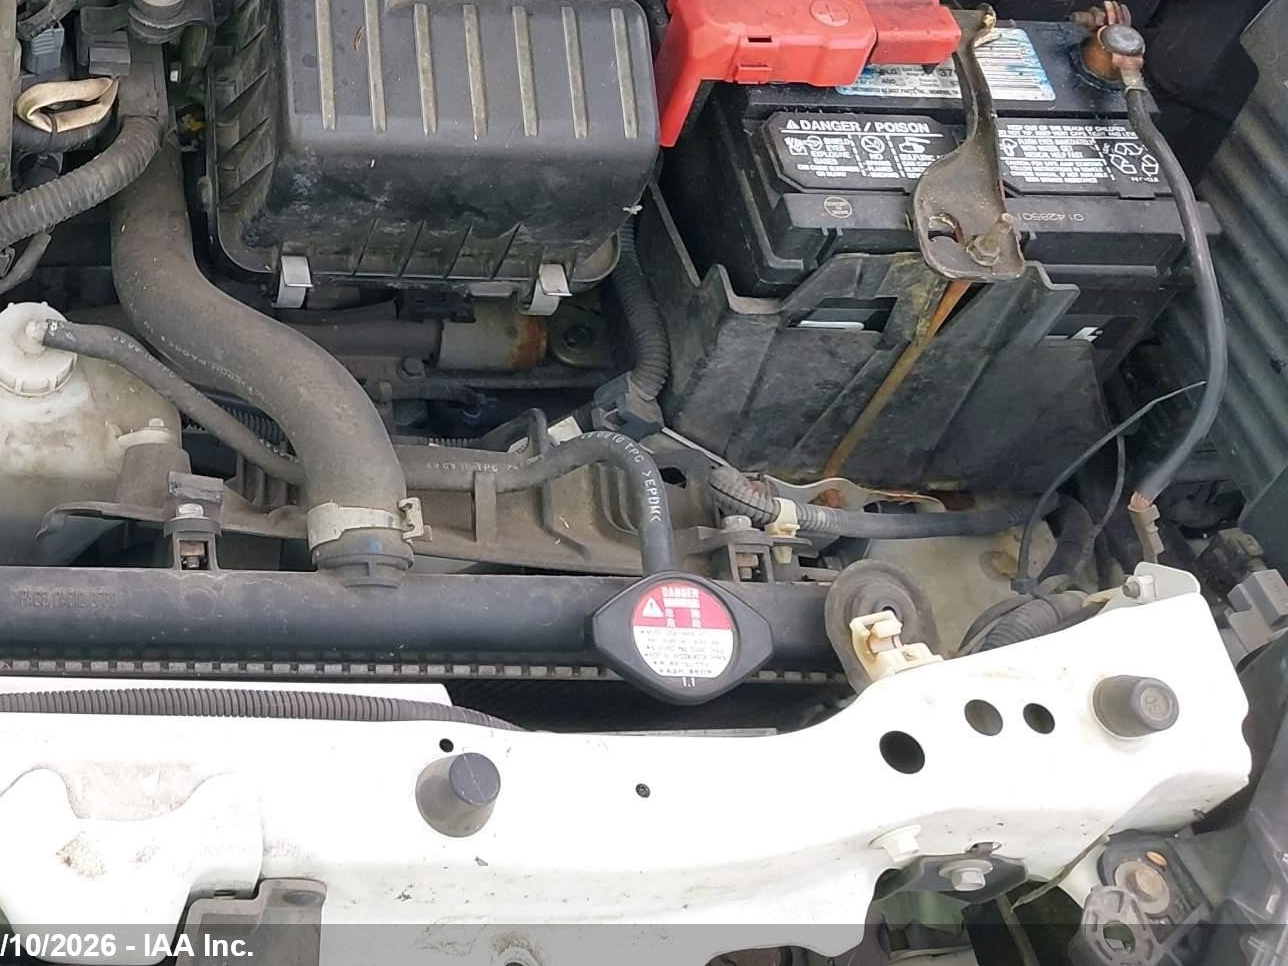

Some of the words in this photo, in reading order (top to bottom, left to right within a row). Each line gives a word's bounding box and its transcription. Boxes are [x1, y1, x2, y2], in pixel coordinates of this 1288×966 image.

[800, 119, 861, 132] DANGER
[874, 121, 930, 133] POISON
[661, 586, 700, 598] DANGER
[682, 676, 696, 687] 1.1
